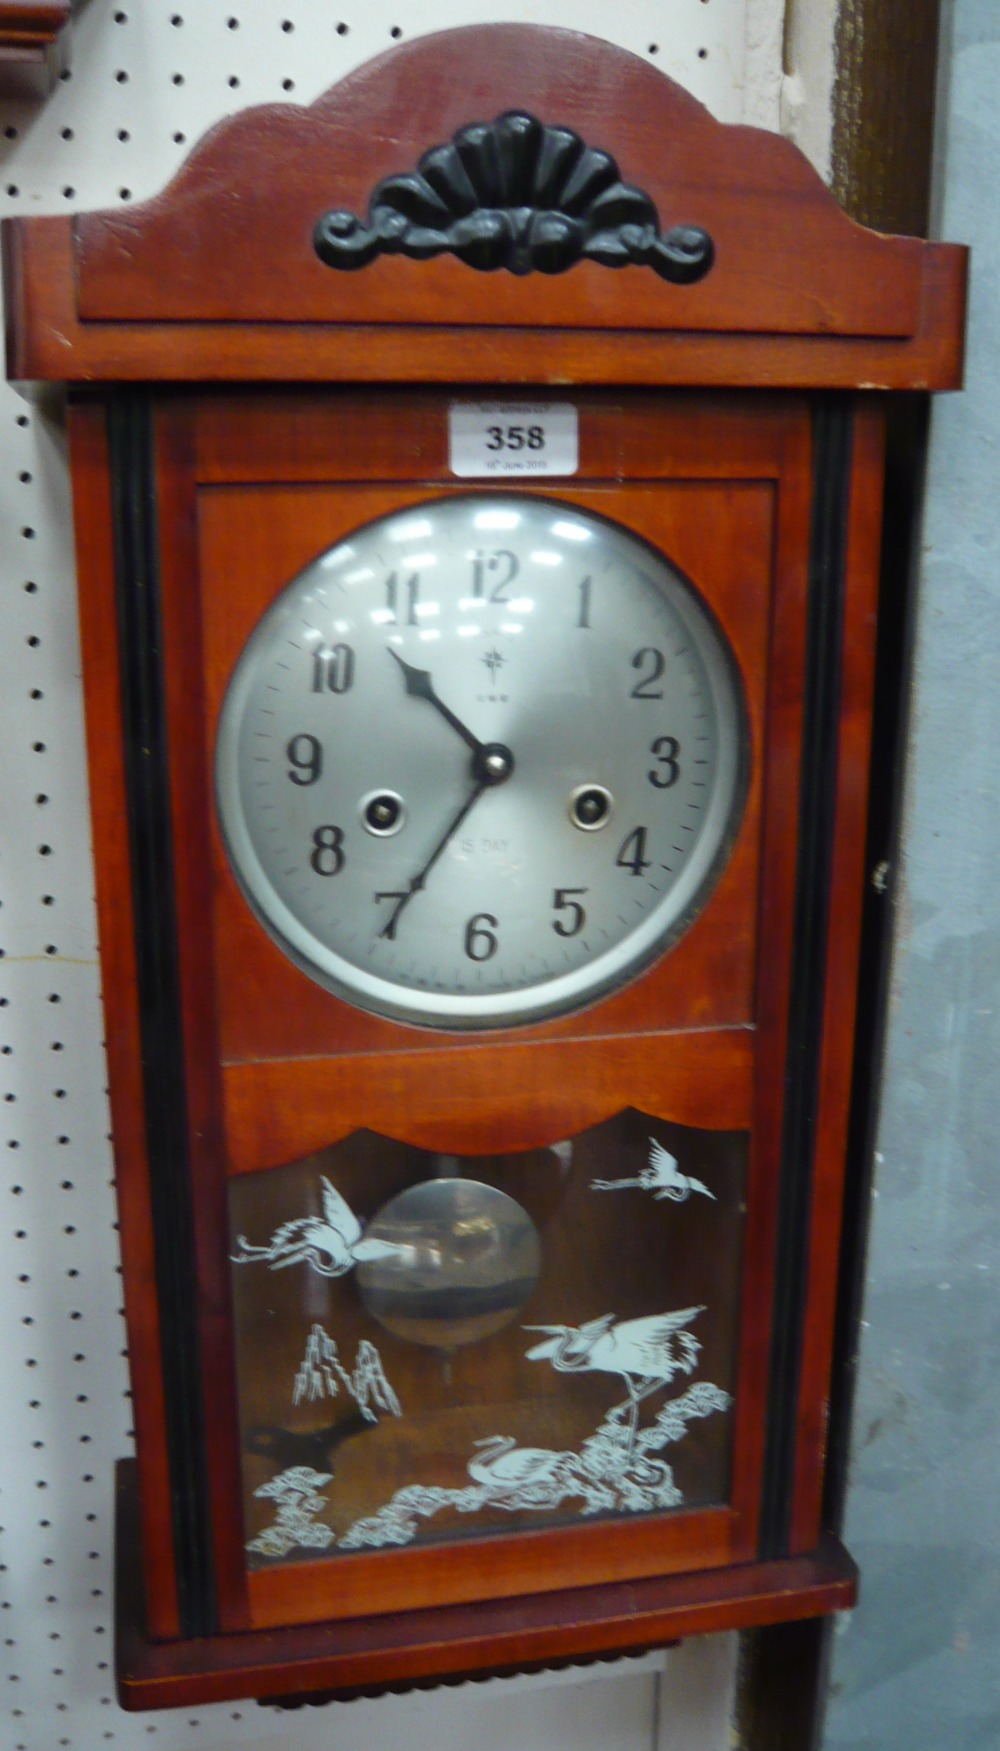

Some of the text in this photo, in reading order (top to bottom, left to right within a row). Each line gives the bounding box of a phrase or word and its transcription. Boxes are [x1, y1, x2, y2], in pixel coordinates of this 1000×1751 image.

[486, 425, 546, 450] 358
[384, 570, 421, 627] 11
[472, 549, 521, 604] 12
[575, 573, 593, 629] 1
[311, 642, 356, 695] 10
[631, 647, 667, 701] 2
[286, 733, 325, 787] 9
[648, 736, 682, 790] 3
[310, 824, 346, 877] 8
[615, 826, 651, 877] 4
[374, 891, 412, 941] 7
[464, 913, 499, 962] 6
[551, 887, 589, 937] 5
